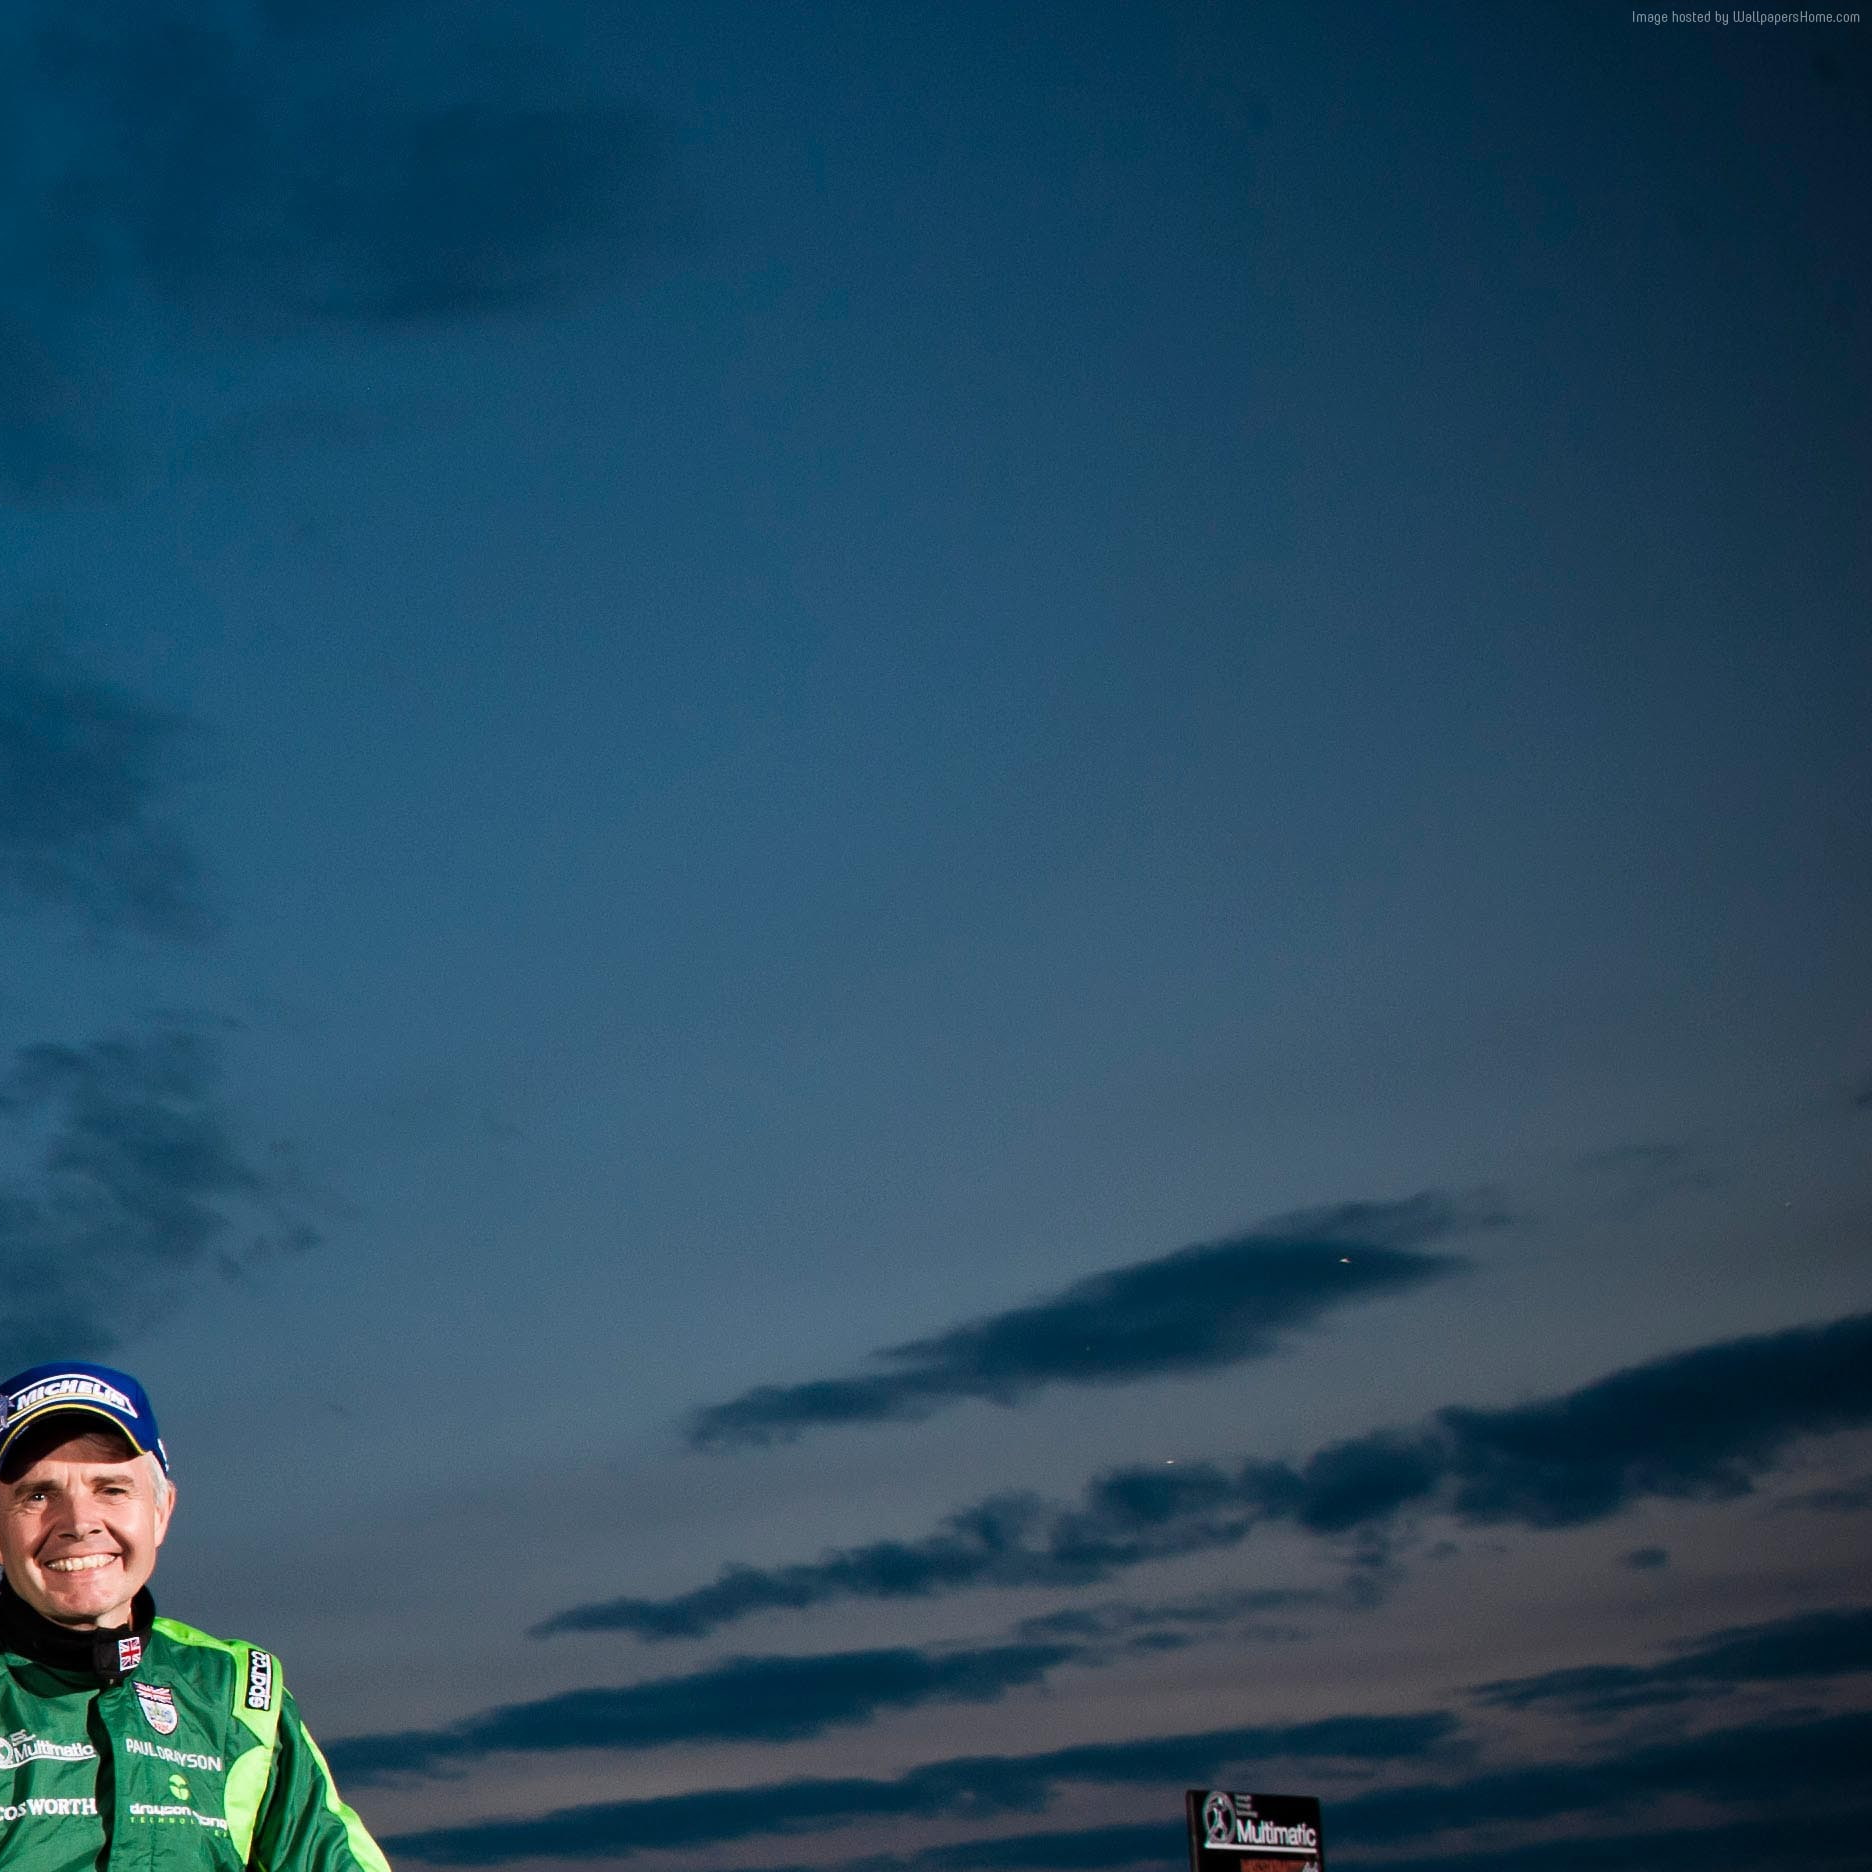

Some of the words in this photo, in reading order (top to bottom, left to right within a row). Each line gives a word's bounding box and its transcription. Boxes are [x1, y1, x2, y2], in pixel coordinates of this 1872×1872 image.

[17, 1379, 132, 1410] MICHELIN
[13, 1739, 95, 1763] Multimatic
[126, 1739, 157, 1756] PAUL
[1236, 1819, 1316, 1847] Multimatic
